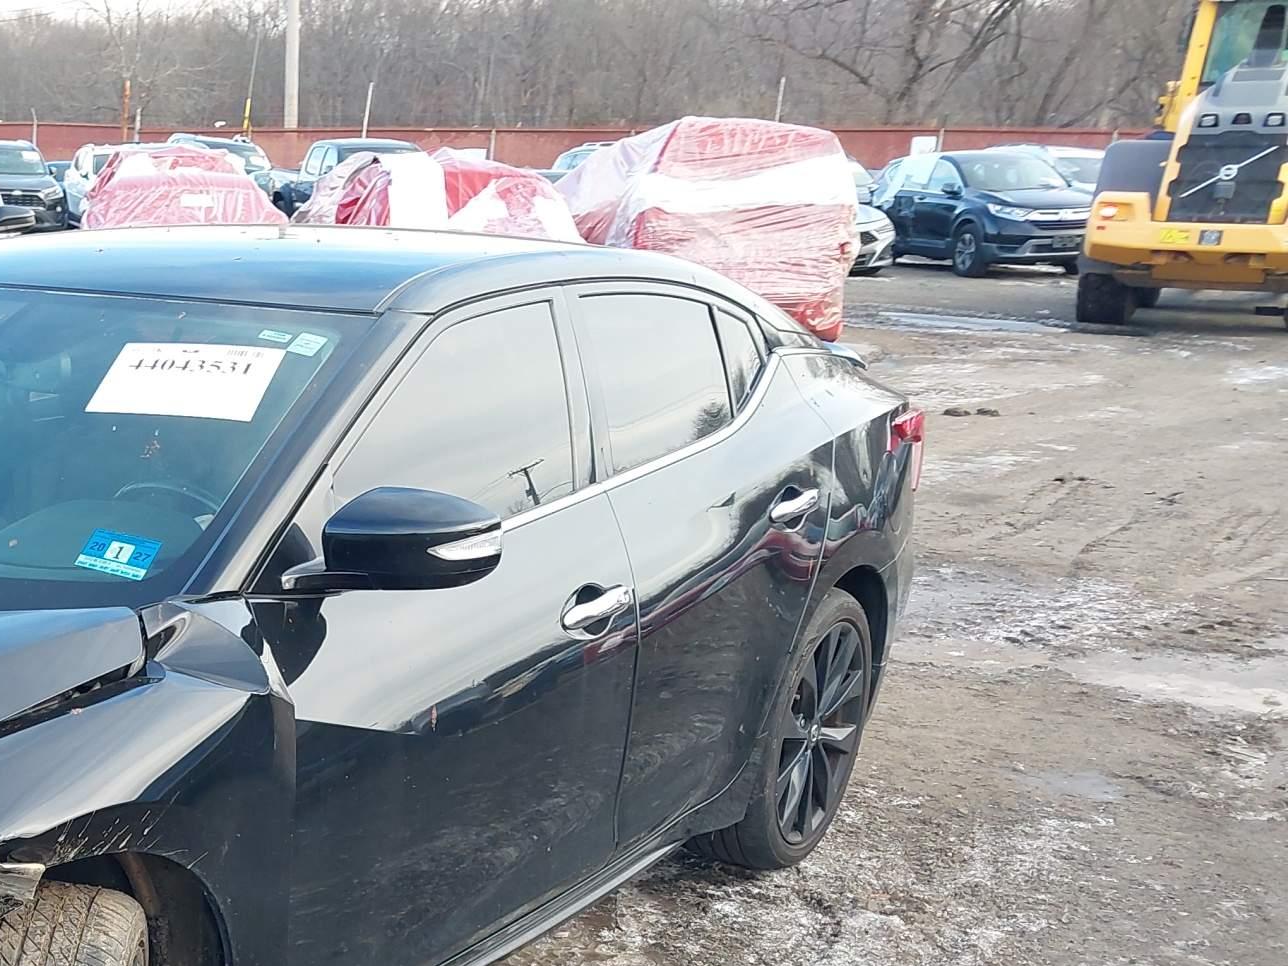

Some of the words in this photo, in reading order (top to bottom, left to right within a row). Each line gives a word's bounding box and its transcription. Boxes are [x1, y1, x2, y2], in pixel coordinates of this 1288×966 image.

[128, 358, 252, 375] 44043531
[89, 541, 106, 552] 20
[113, 546, 124, 559] 1
[133, 552, 152, 562] 27
